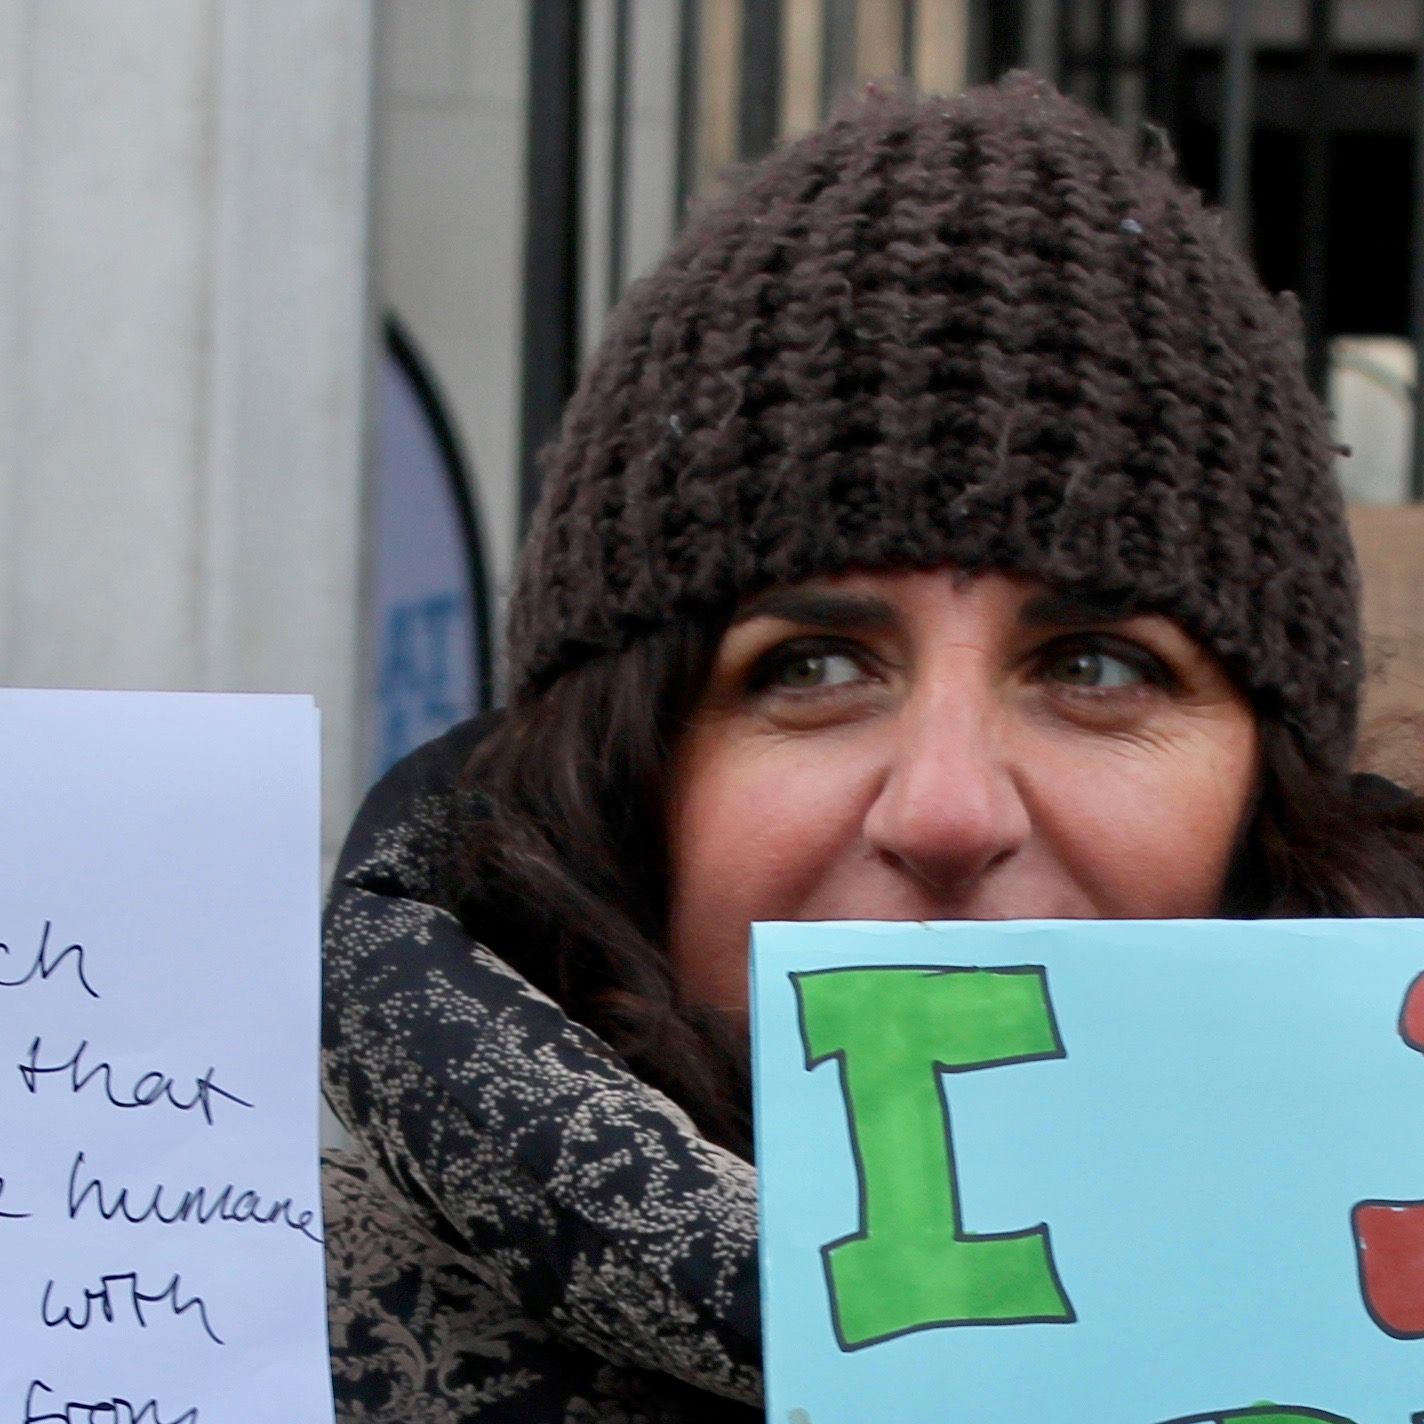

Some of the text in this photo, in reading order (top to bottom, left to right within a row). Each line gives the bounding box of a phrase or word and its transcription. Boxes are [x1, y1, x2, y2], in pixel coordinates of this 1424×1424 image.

[19, 1036, 254, 1124] that
[68, 1151, 326, 1244] humane
[788, 964, 1076, 1353] I
[41, 1272, 226, 1345] with
